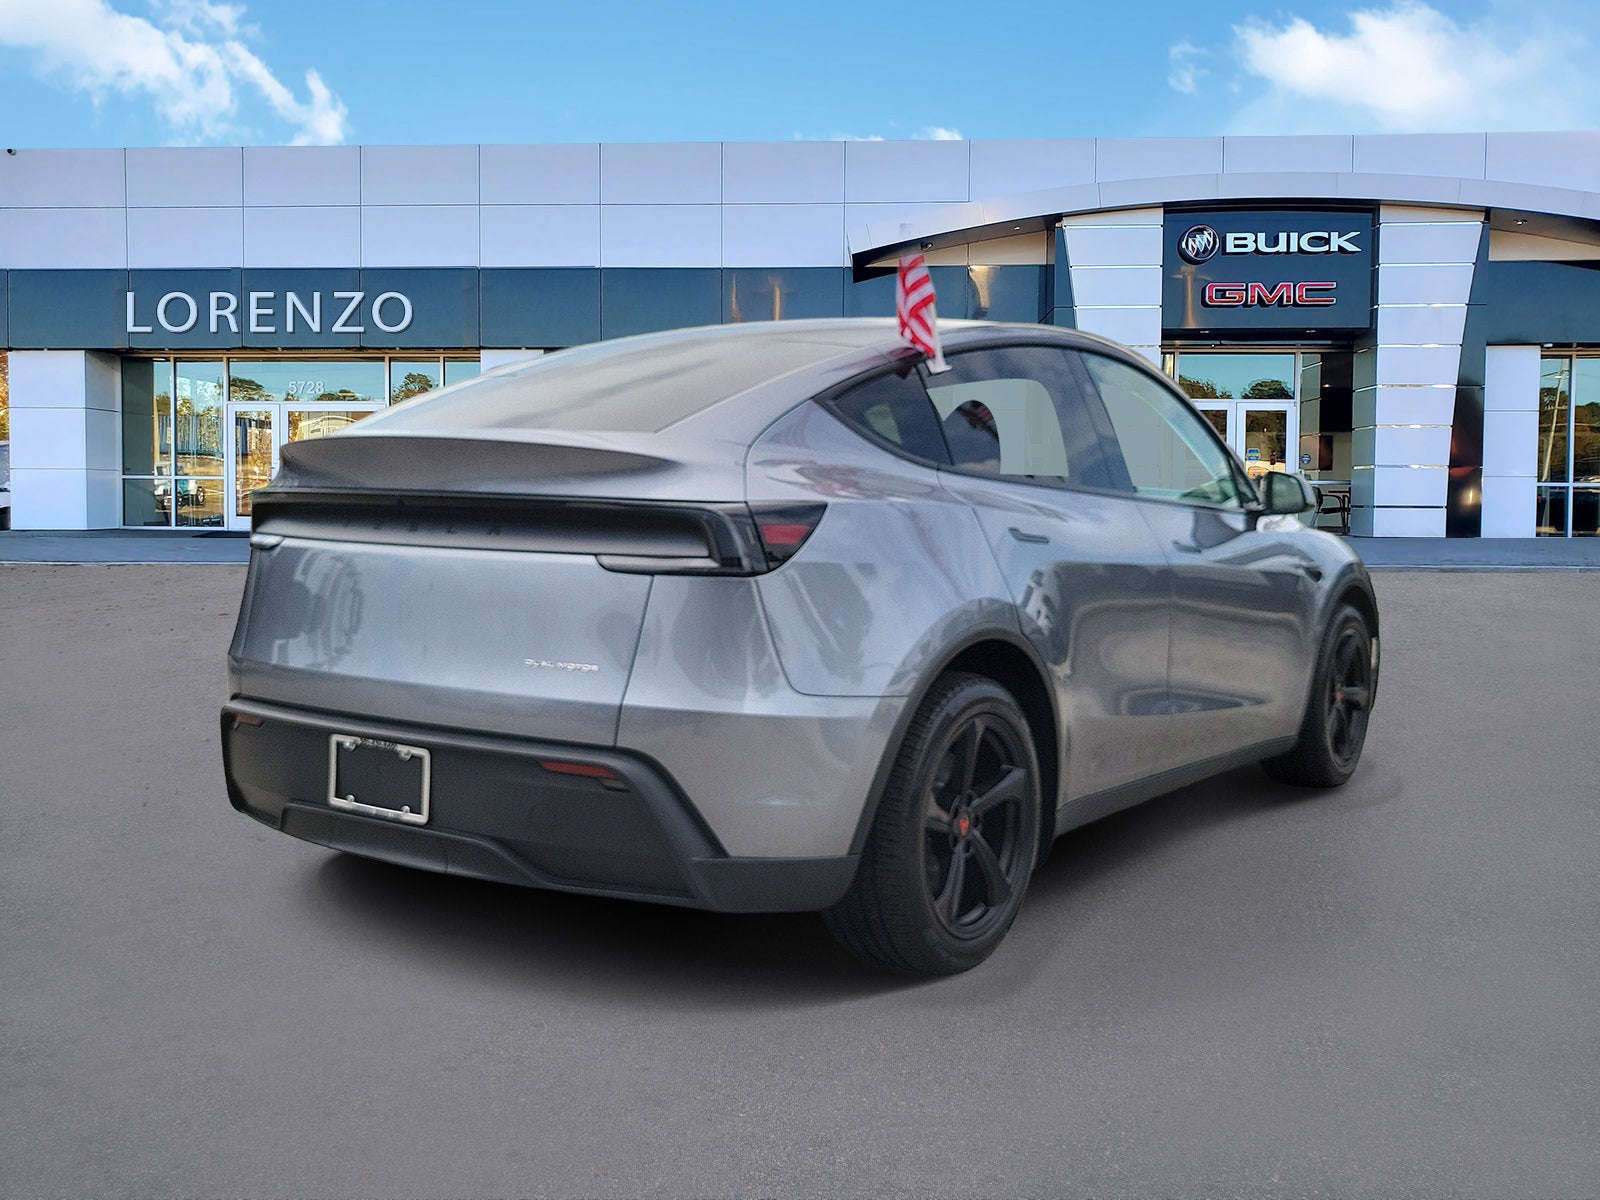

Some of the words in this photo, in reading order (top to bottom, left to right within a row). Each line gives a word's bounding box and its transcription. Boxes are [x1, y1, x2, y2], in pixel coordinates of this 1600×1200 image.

[1225, 231, 1362, 253] BUICK
[1205, 282, 1337, 305] GMC
[125, 291, 414, 334] LORENZO
[288, 381, 326, 395] 5728
